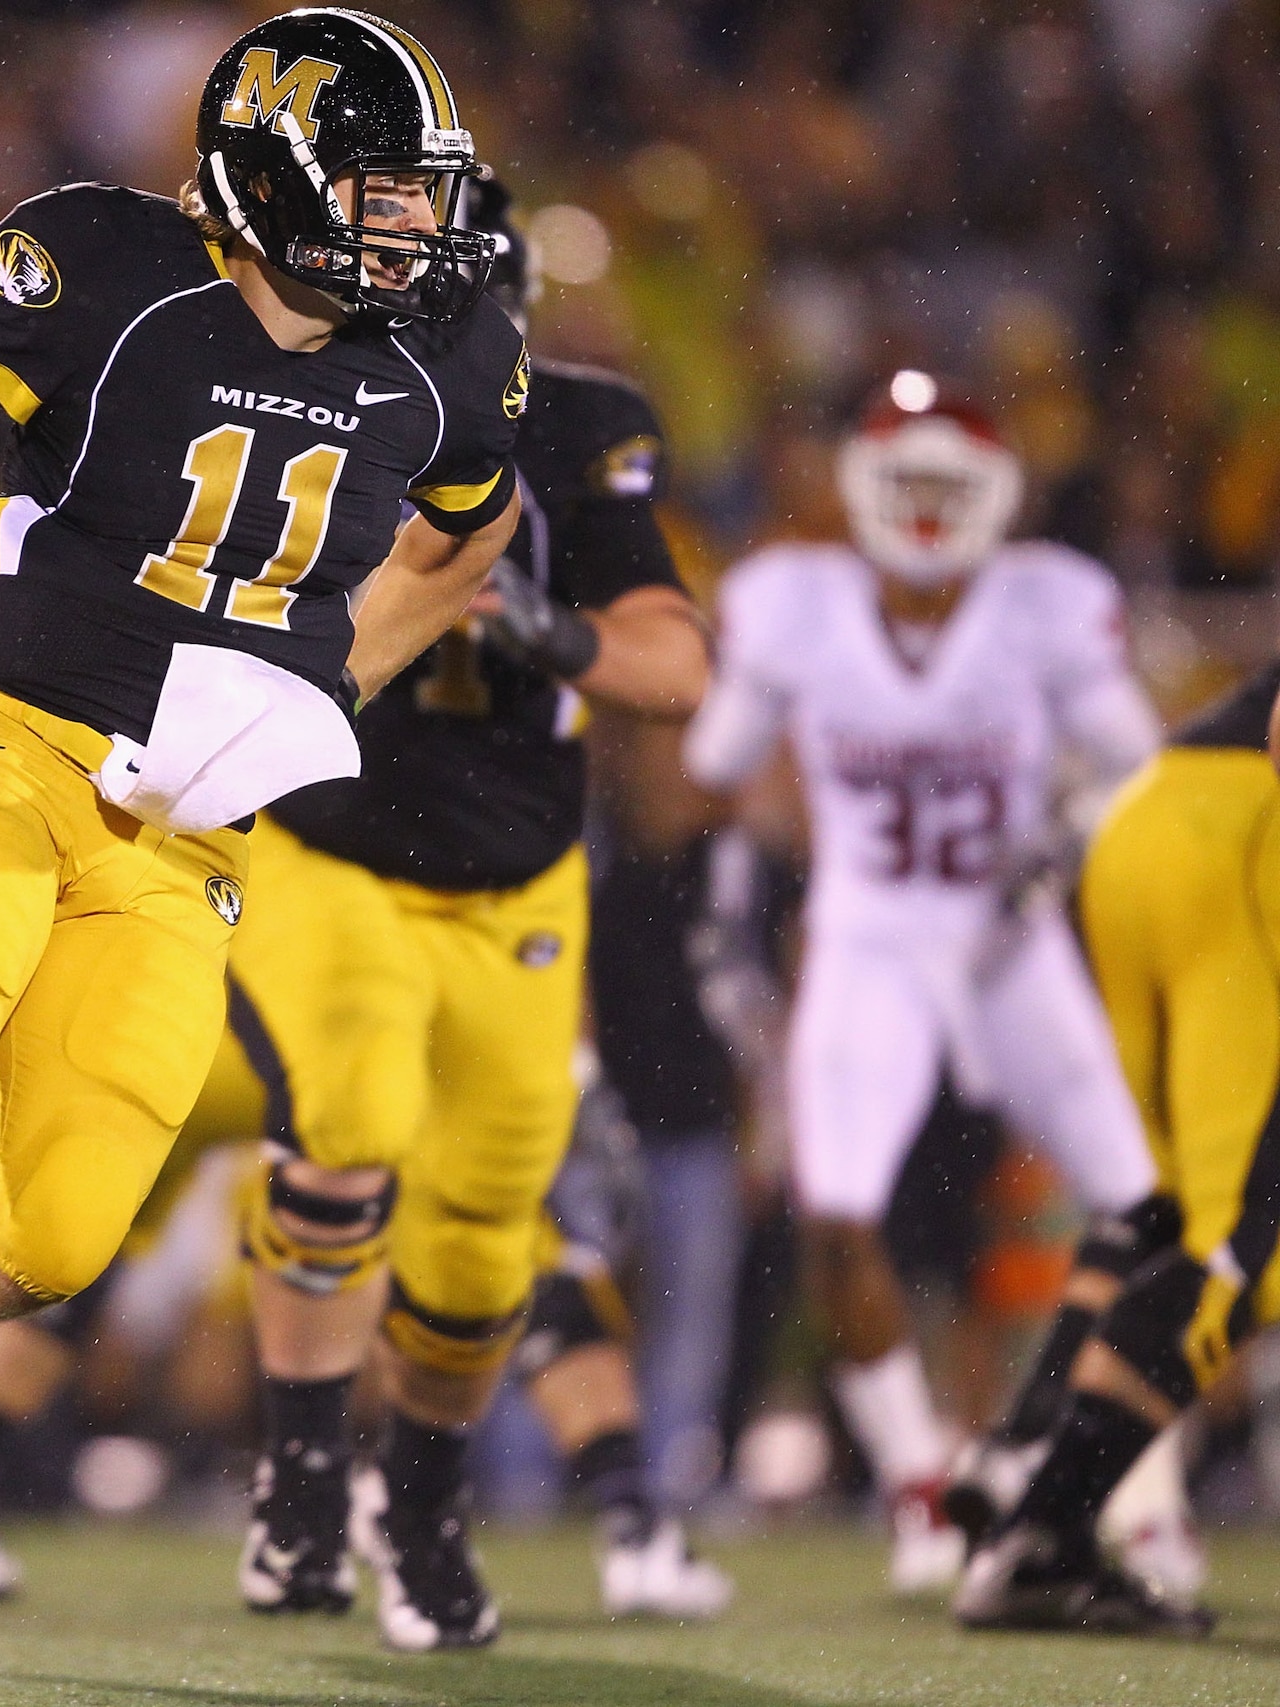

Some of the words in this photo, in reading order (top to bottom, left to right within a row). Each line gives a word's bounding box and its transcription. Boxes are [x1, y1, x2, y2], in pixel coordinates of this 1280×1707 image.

[220, 47, 342, 144] M
[208, 384, 361, 433] MIZZOU
[132, 422, 350, 632] 11
[834, 768, 1008, 885] 32
